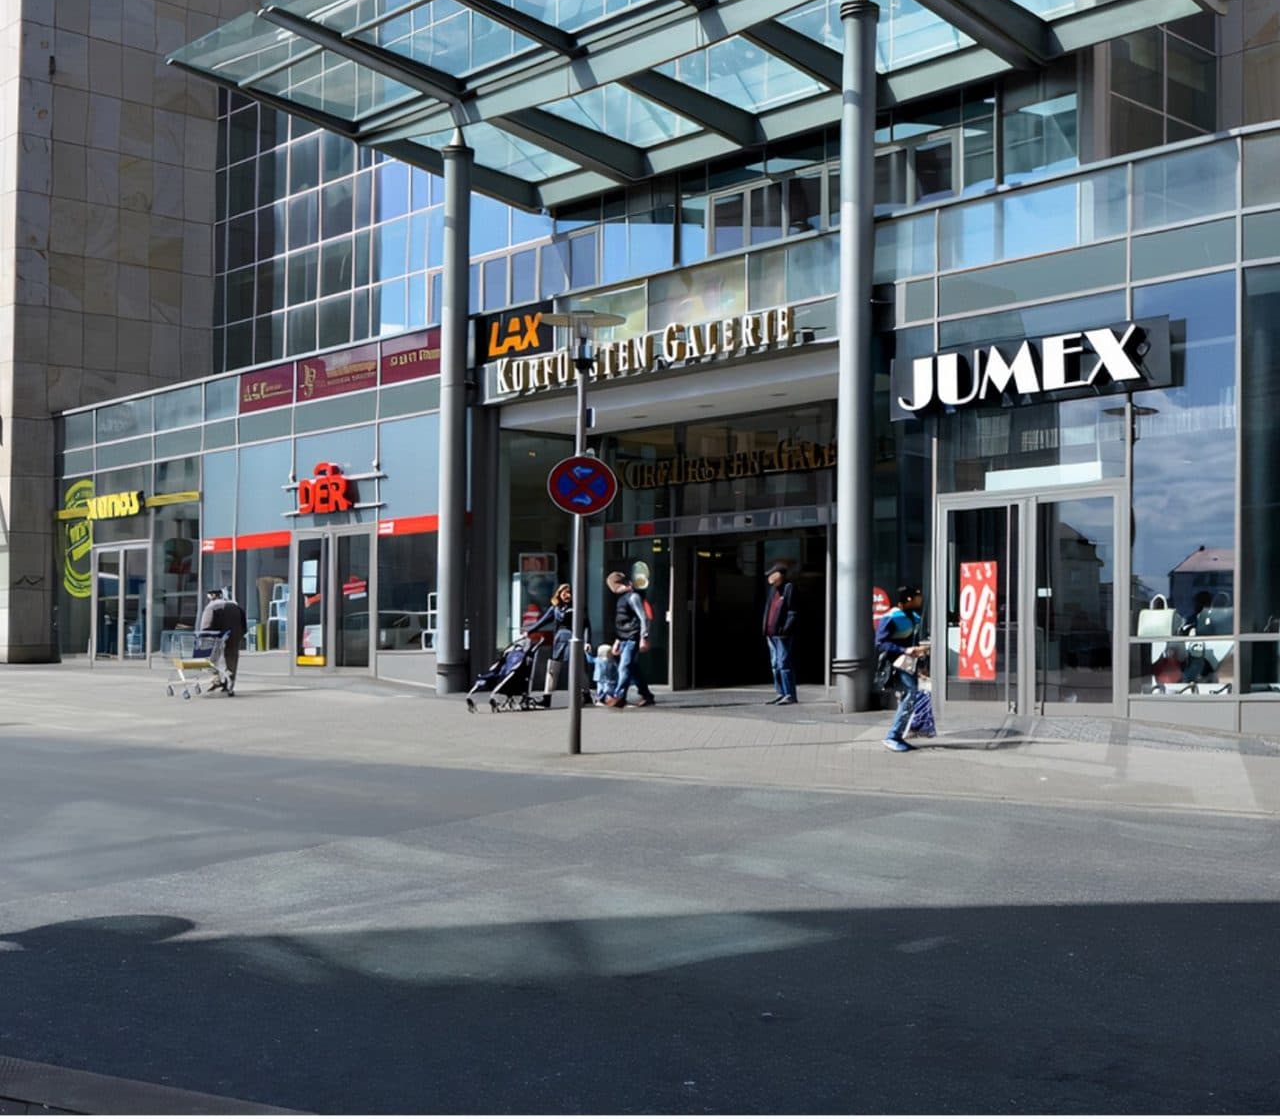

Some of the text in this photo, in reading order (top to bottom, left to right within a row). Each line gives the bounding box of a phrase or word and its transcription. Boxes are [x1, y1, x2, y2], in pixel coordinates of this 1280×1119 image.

[488, 312, 543, 358] LAX
[898, 323, 1141, 411] JUMEX
[298, 476, 350, 514] DER
